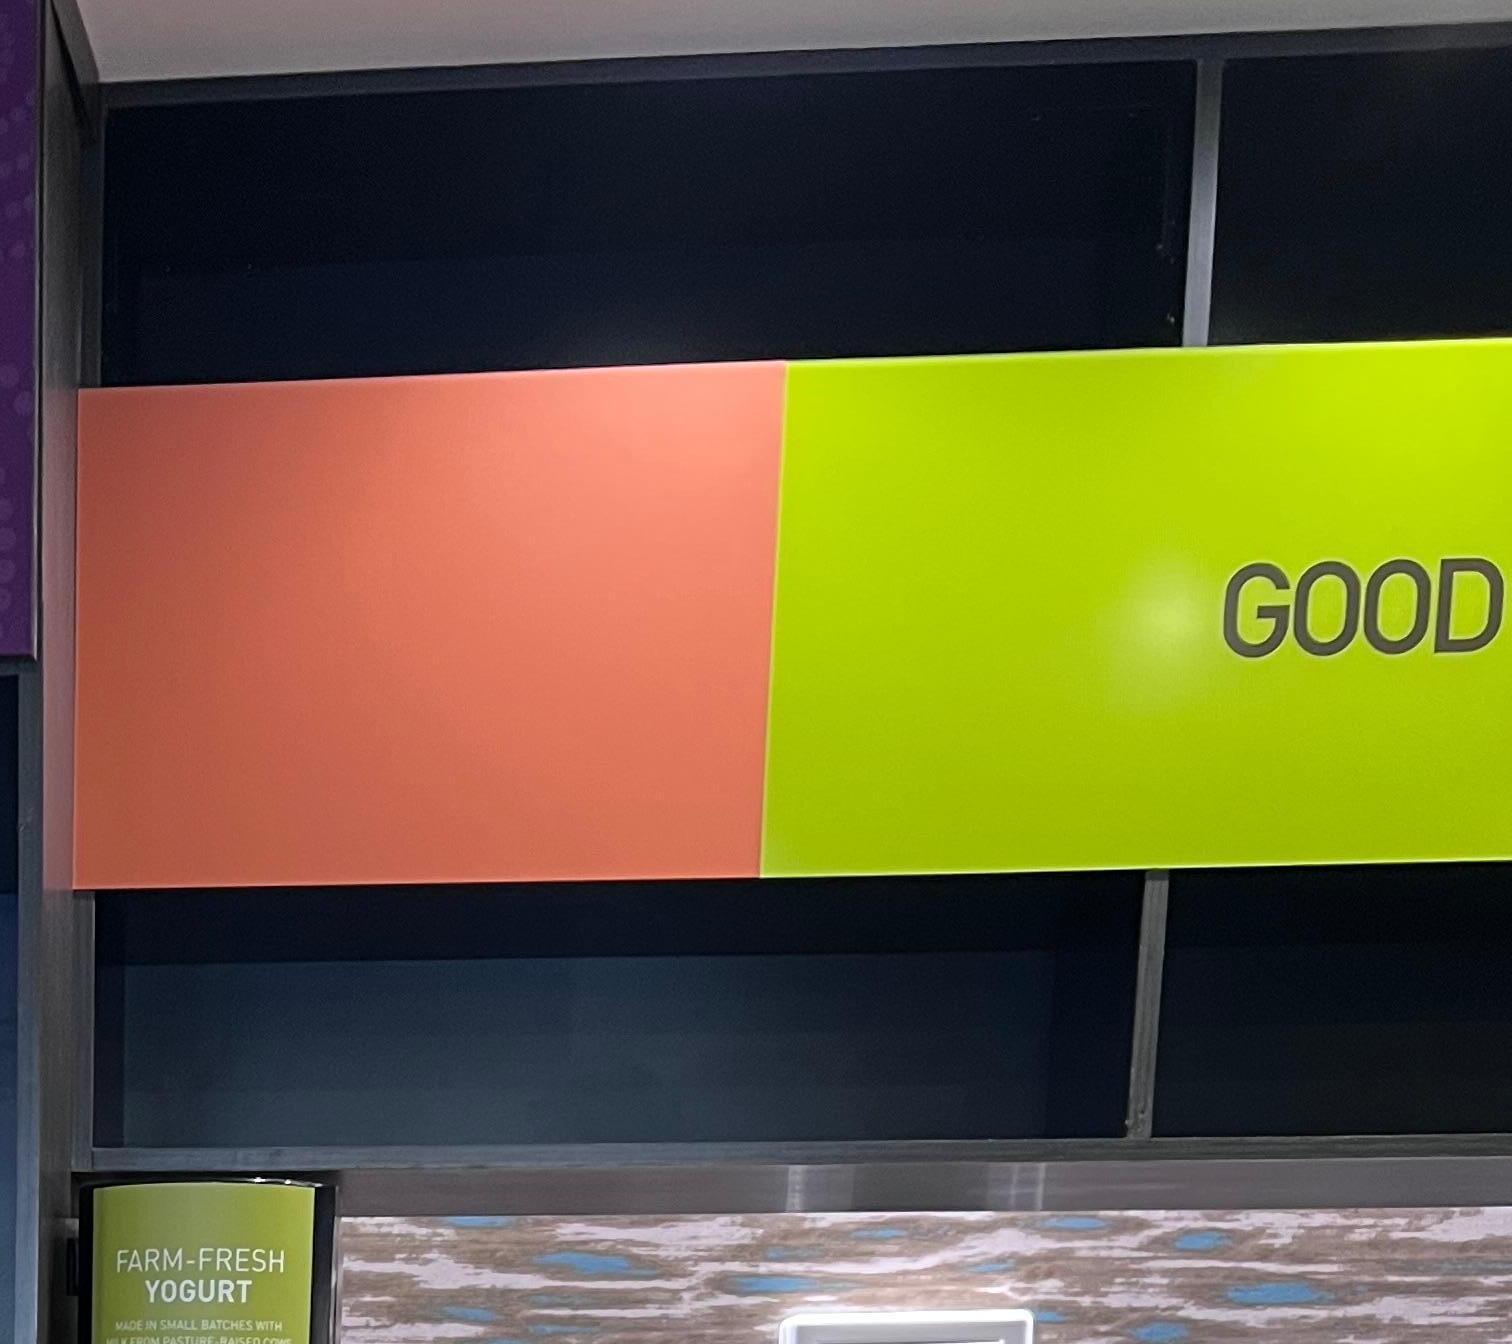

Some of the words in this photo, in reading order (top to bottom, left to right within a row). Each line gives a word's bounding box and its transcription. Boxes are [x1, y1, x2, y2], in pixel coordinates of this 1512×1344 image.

[1223, 557, 1505, 659] GOOD
[115, 1247, 286, 1274] FARM-FRESH
[144, 1279, 253, 1303] YOGURT
[115, 1320, 143, 1331] MADE
[145, 1320, 157, 1331] IN
[159, 1319, 198, 1331] SMALL
[201, 1319, 254, 1331] BATCHES
[255, 1321, 283, 1331] WITH
